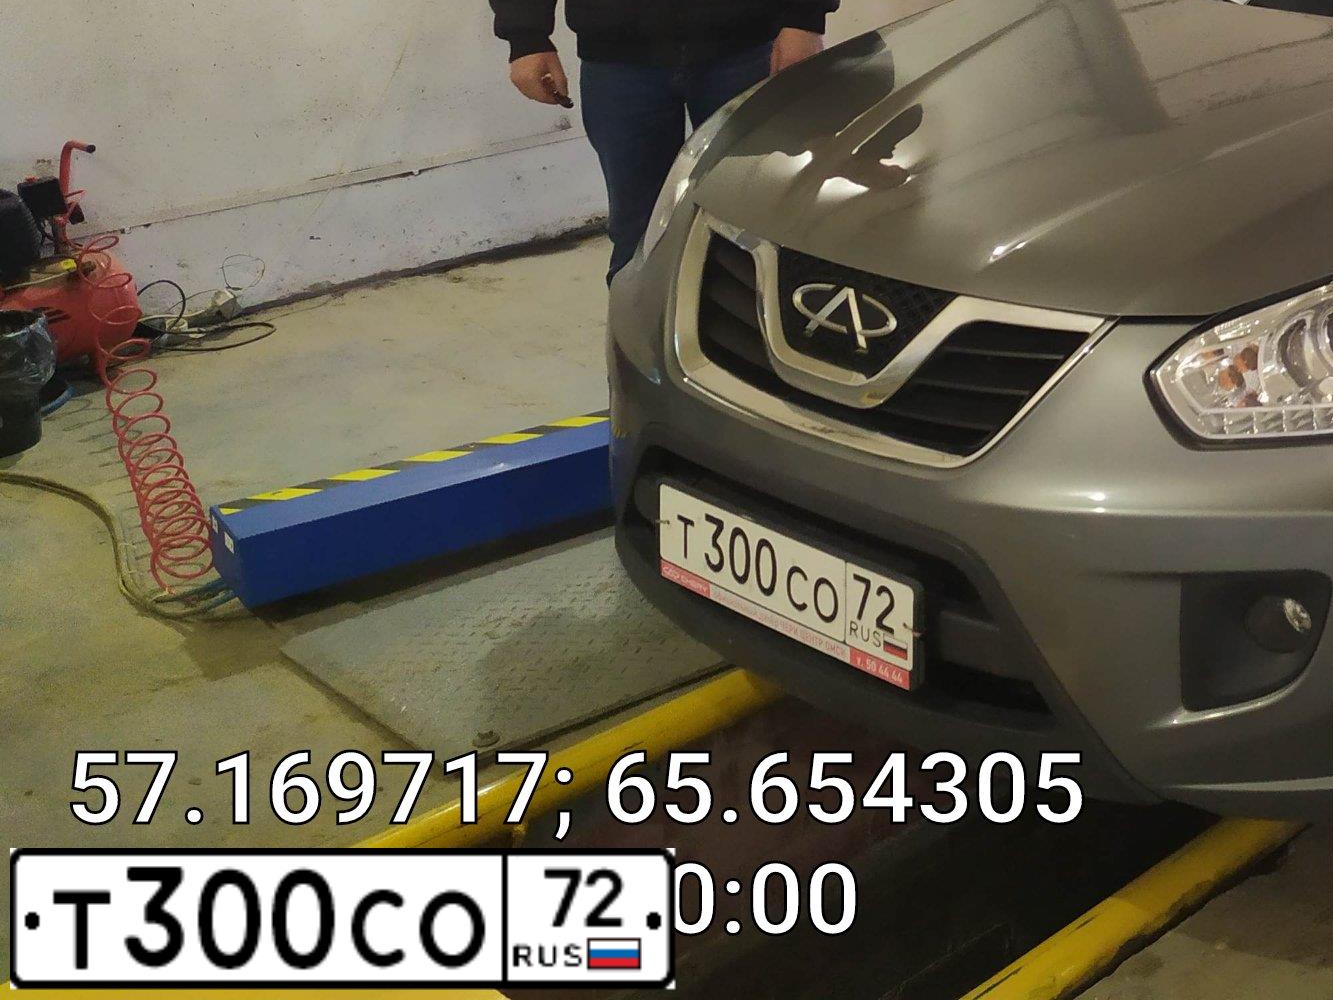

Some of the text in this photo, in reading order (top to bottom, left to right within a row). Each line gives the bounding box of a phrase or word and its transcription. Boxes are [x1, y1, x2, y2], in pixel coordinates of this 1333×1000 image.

[676, 513, 839, 623] Т300СО
[853, 573, 895, 635] 72
[849, 621, 881, 648] RUS
